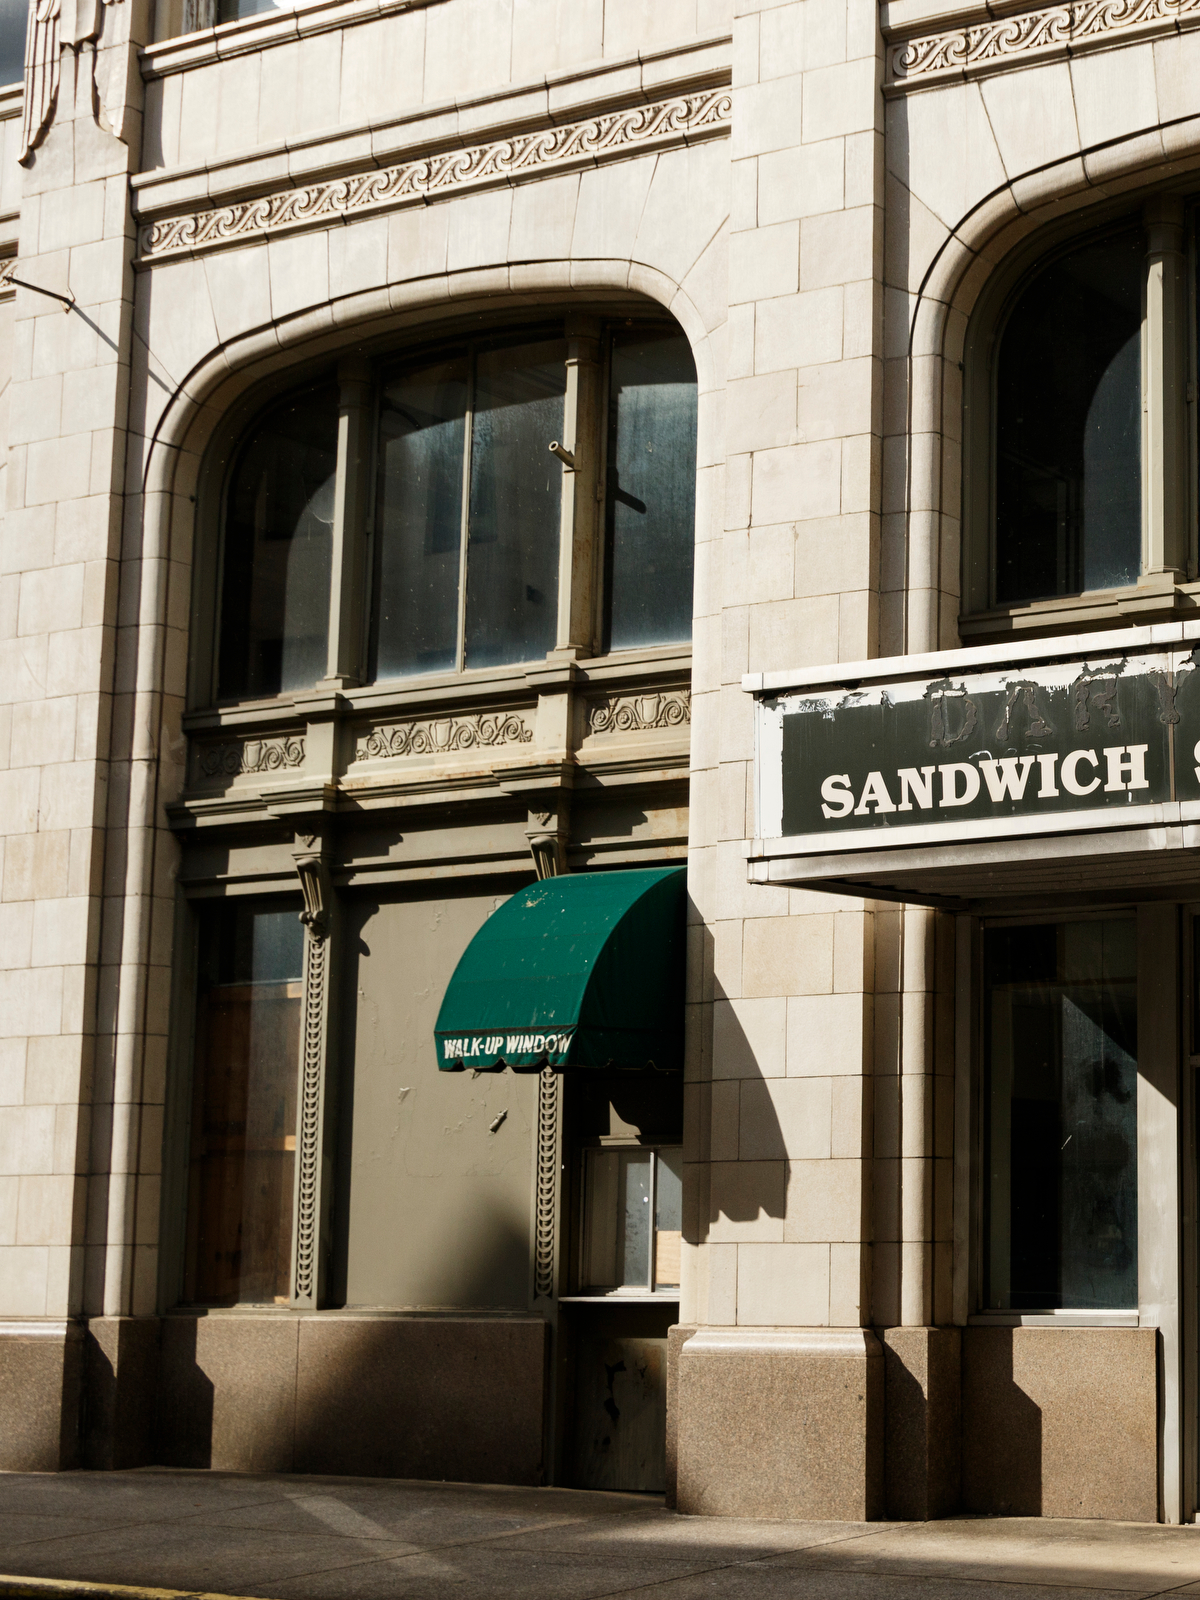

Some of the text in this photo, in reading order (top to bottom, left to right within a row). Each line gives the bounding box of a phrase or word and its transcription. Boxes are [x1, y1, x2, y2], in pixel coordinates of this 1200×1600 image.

[820, 743, 1149, 820] SANDWICH
[444, 1034, 573, 1059] WALK-UP WINDOW
